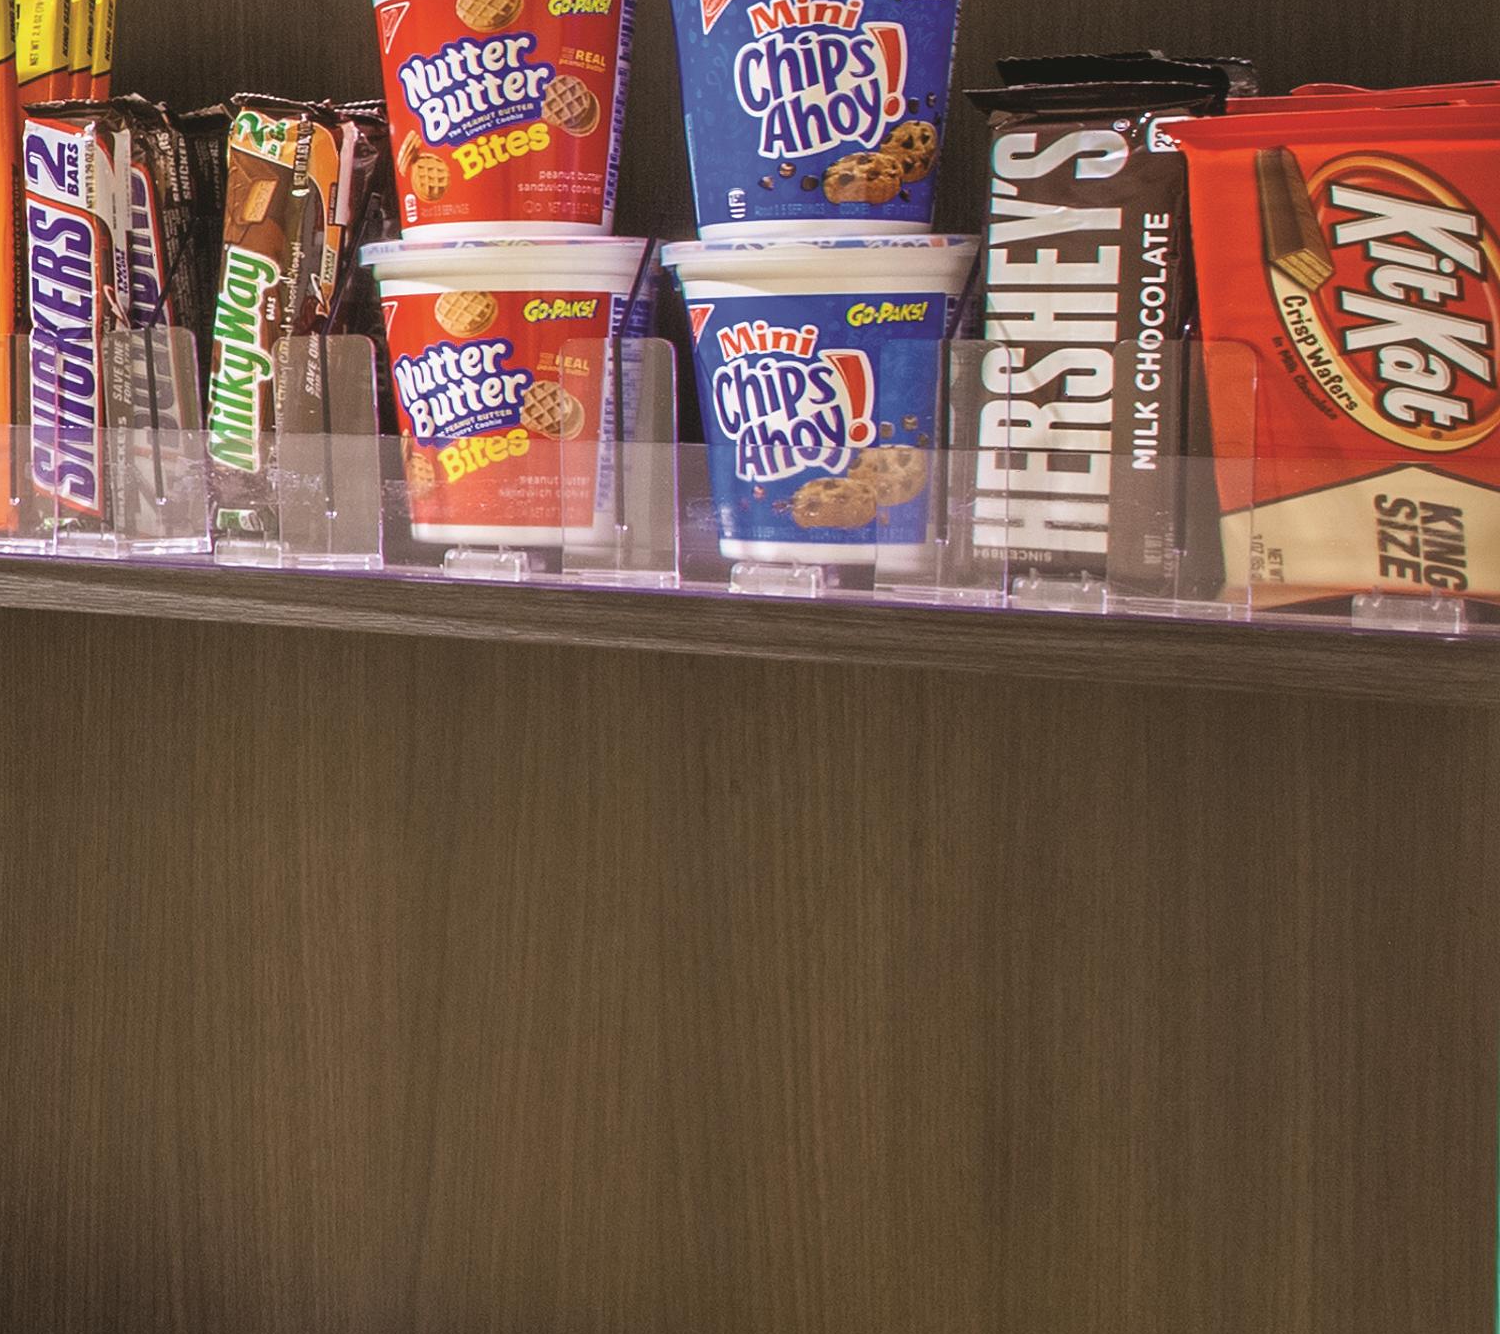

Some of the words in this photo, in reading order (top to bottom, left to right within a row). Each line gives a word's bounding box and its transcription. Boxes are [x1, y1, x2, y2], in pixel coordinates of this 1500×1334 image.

[401, 37, 531, 109] Nutter
[575, 49, 606, 67] REAL
[737, 35, 875, 103] Chips
[419, 67, 549, 142] Butter
[27, 134, 67, 189] 2
[67, 143, 80, 196] BARS
[452, 123, 550, 180] Bites
[1134, 211, 1170, 392] CHOCOLATE
[28, 207, 98, 505] SNICKERS
[717, 322, 819, 361] Mini
[972, 128, 1131, 552] HERSHEY'S
[1281, 293, 1318, 347] Crisp
[1304, 345, 1359, 415] Wafers
[396, 343, 506, 407] Nutter
[409, 373, 526, 438] Butter
[714, 357, 836, 433] Chips
[438, 429, 530, 483] Bites
[1131, 402, 1158, 471] MILK
[1374, 493, 1421, 583] SIZE
[1417, 502, 1469, 592] KING
